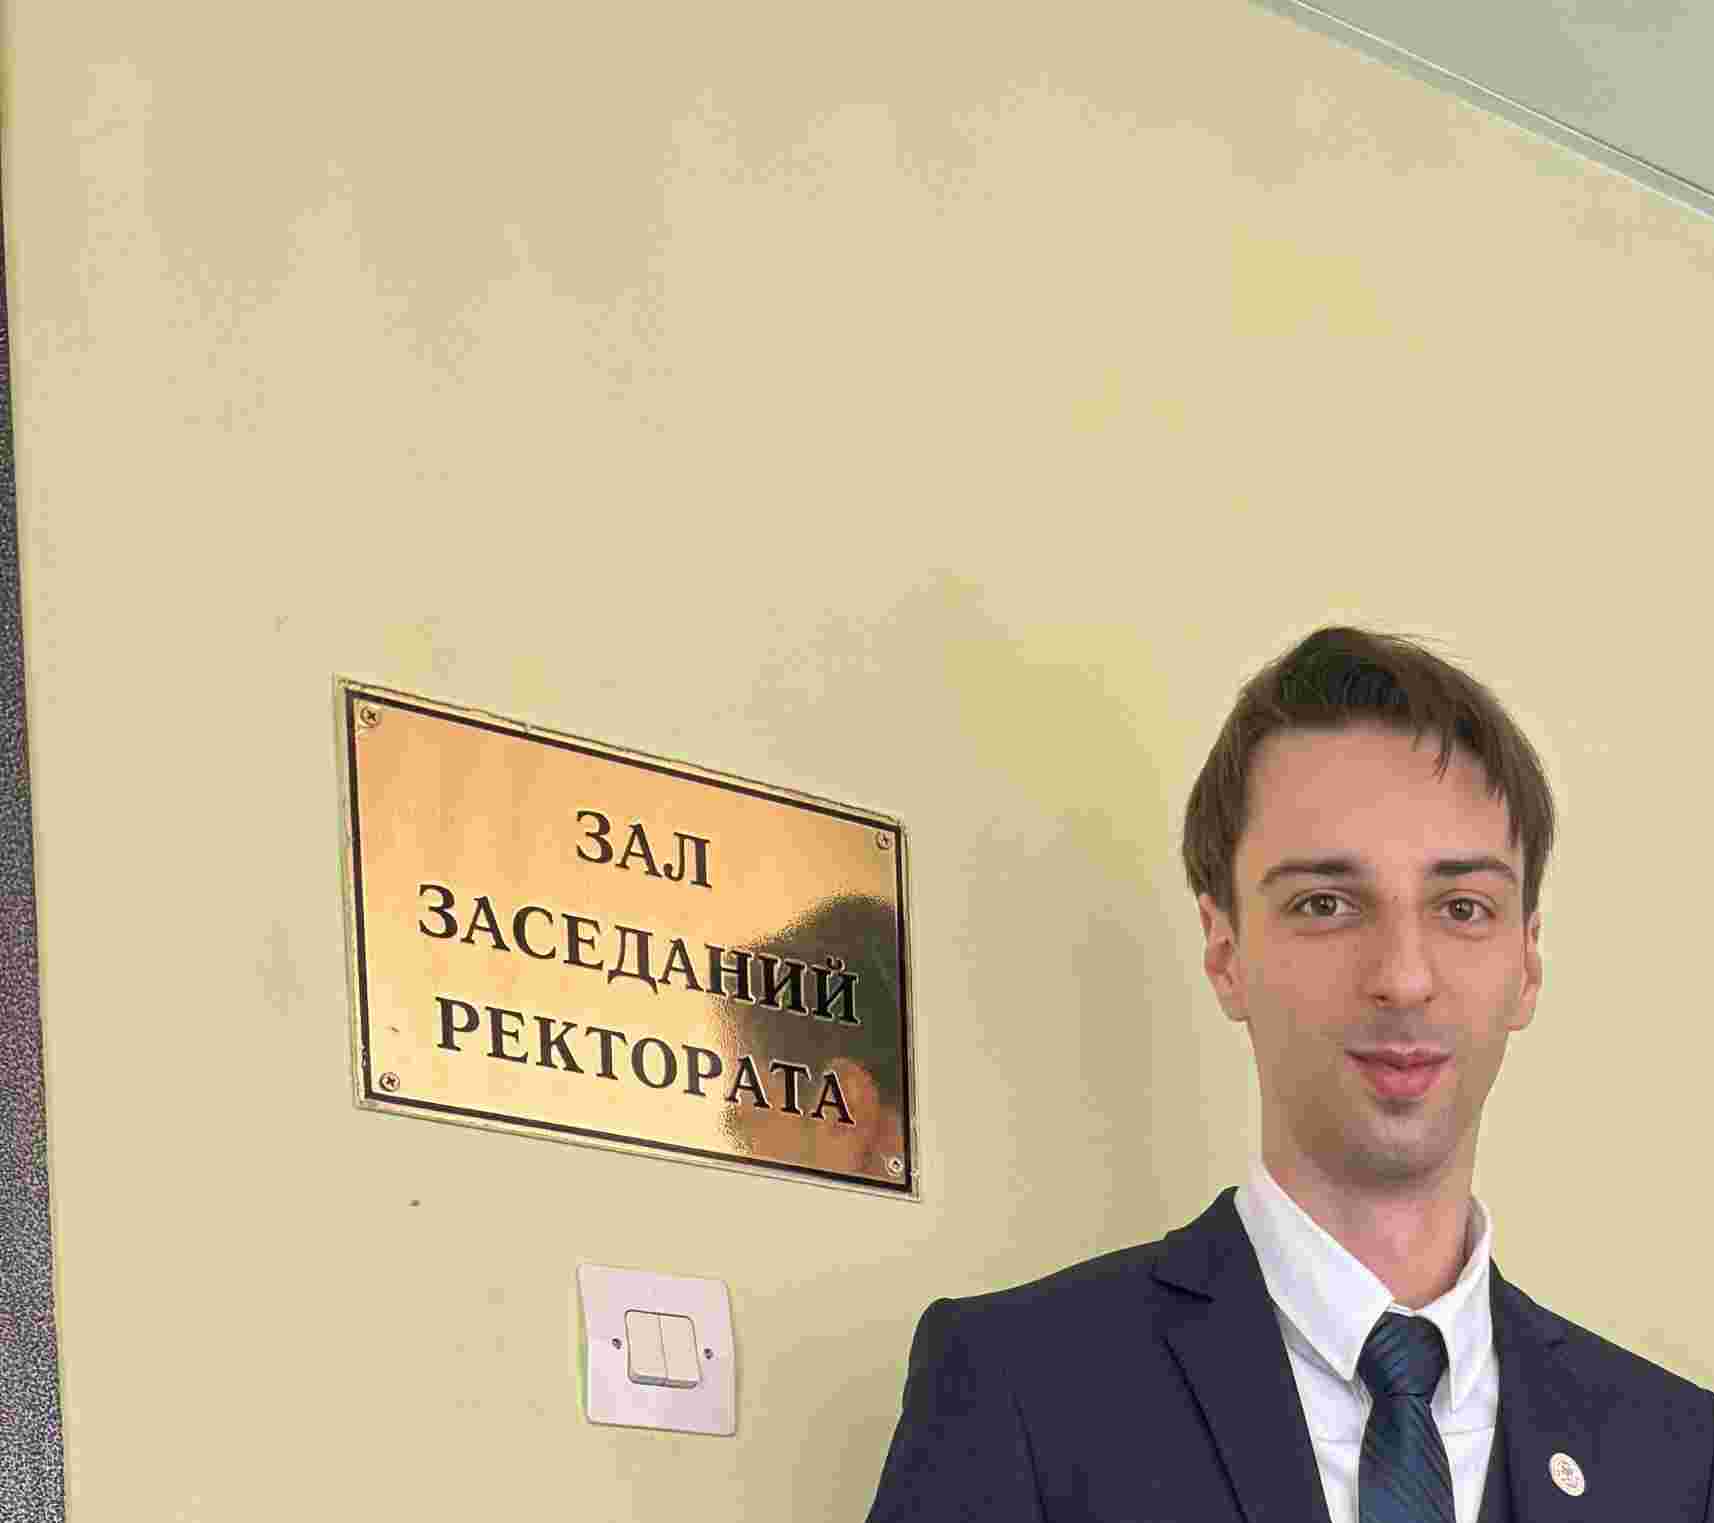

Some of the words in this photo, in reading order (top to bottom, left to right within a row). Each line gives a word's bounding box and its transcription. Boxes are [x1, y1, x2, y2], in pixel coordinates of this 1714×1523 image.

[575, 809, 711, 888] ЗАЛ
[417, 884, 861, 1024] ЗАСЕДАНИЙ
[435, 996, 855, 1125] РЕКТОРАТА
